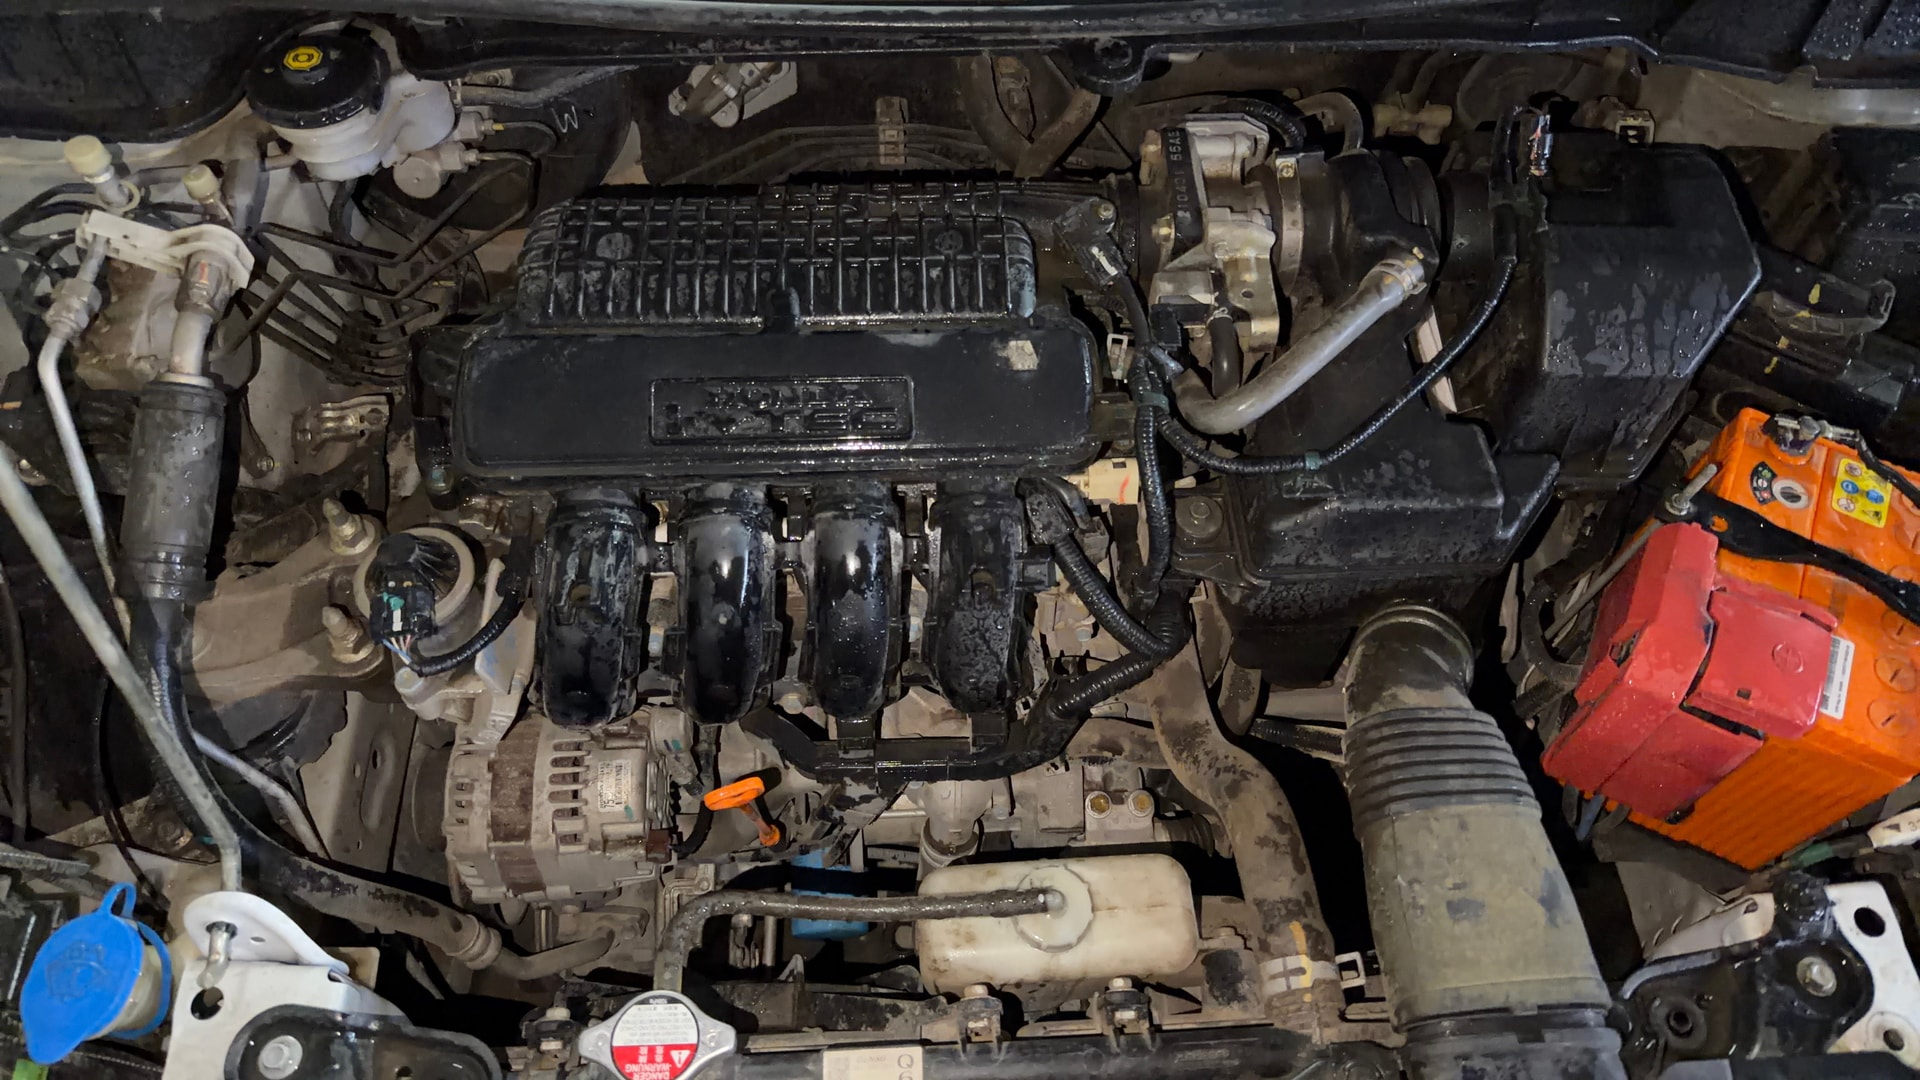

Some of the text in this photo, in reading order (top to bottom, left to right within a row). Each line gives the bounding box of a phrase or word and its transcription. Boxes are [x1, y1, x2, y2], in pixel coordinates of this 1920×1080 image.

[551, 105, 578, 132] W
[897, 1054, 914, 1069] Q
[633, 1072, 670, 1080] DANGER
